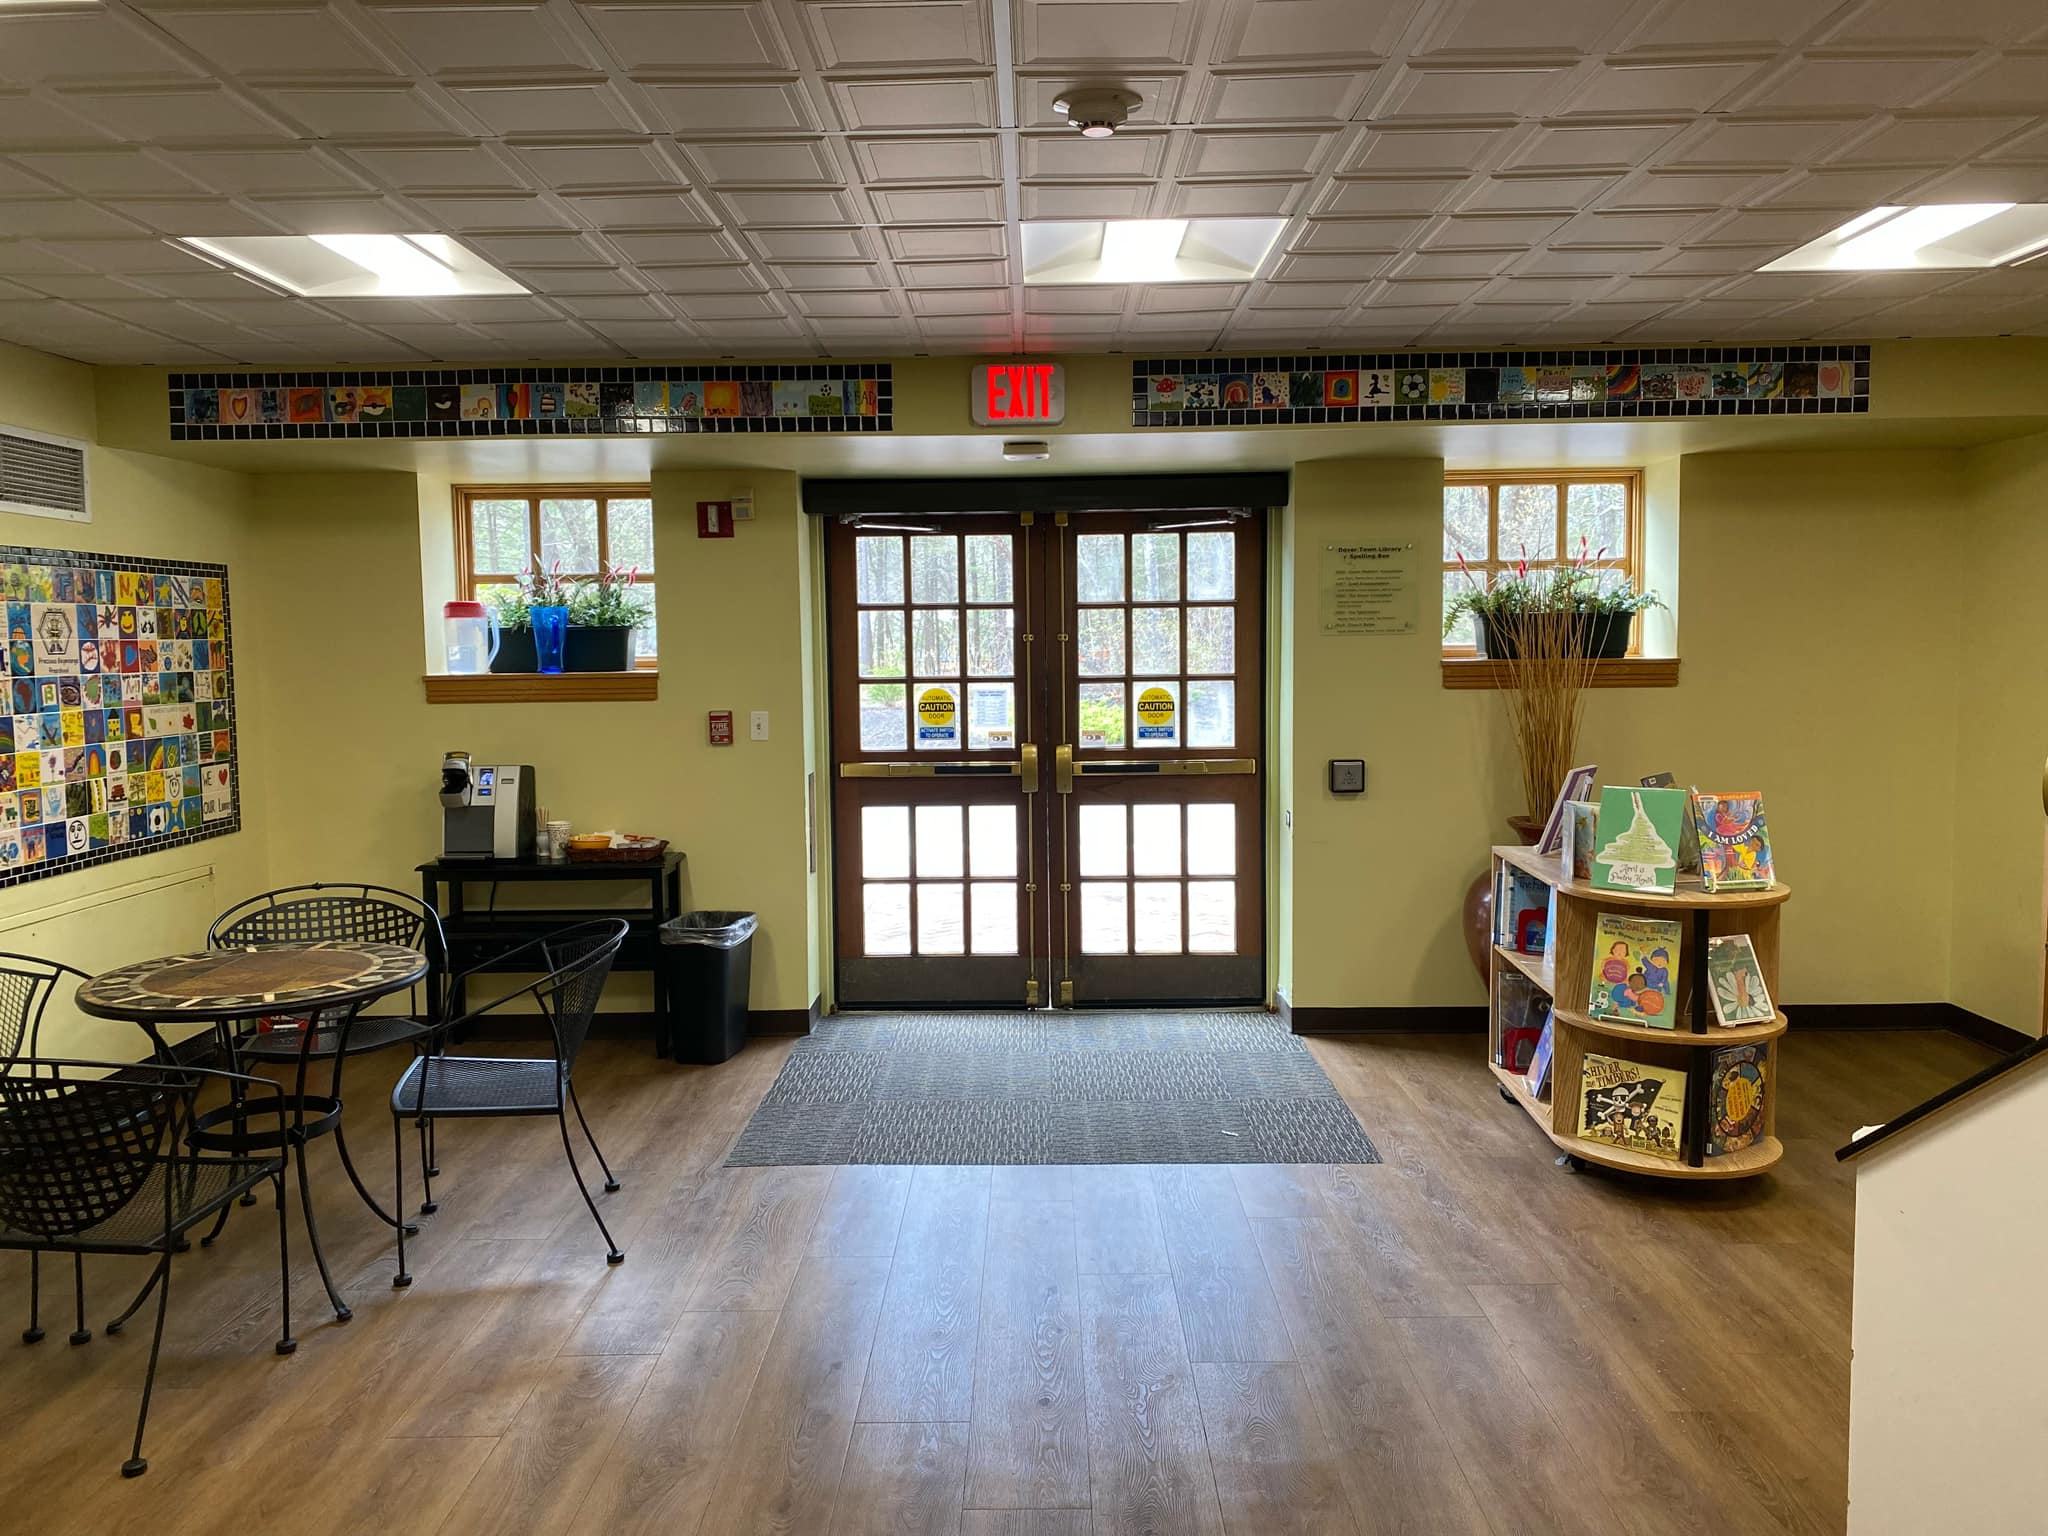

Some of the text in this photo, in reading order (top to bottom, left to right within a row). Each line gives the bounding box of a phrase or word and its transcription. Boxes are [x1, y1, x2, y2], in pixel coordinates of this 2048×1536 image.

[846, 391, 877, 406] READ
[987, 365, 1054, 419] EXIT
[920, 703, 954, 711] CAUTION
[1138, 702, 1173, 711] CAUTION
[711, 722, 728, 730] FIRE
[1714, 836, 1730, 845] AM
[1731, 824, 1759, 845] LOVED
[1586, 1062, 1621, 1078] SHIVER
[1596, 1067, 1641, 1087] TIMBERS!
